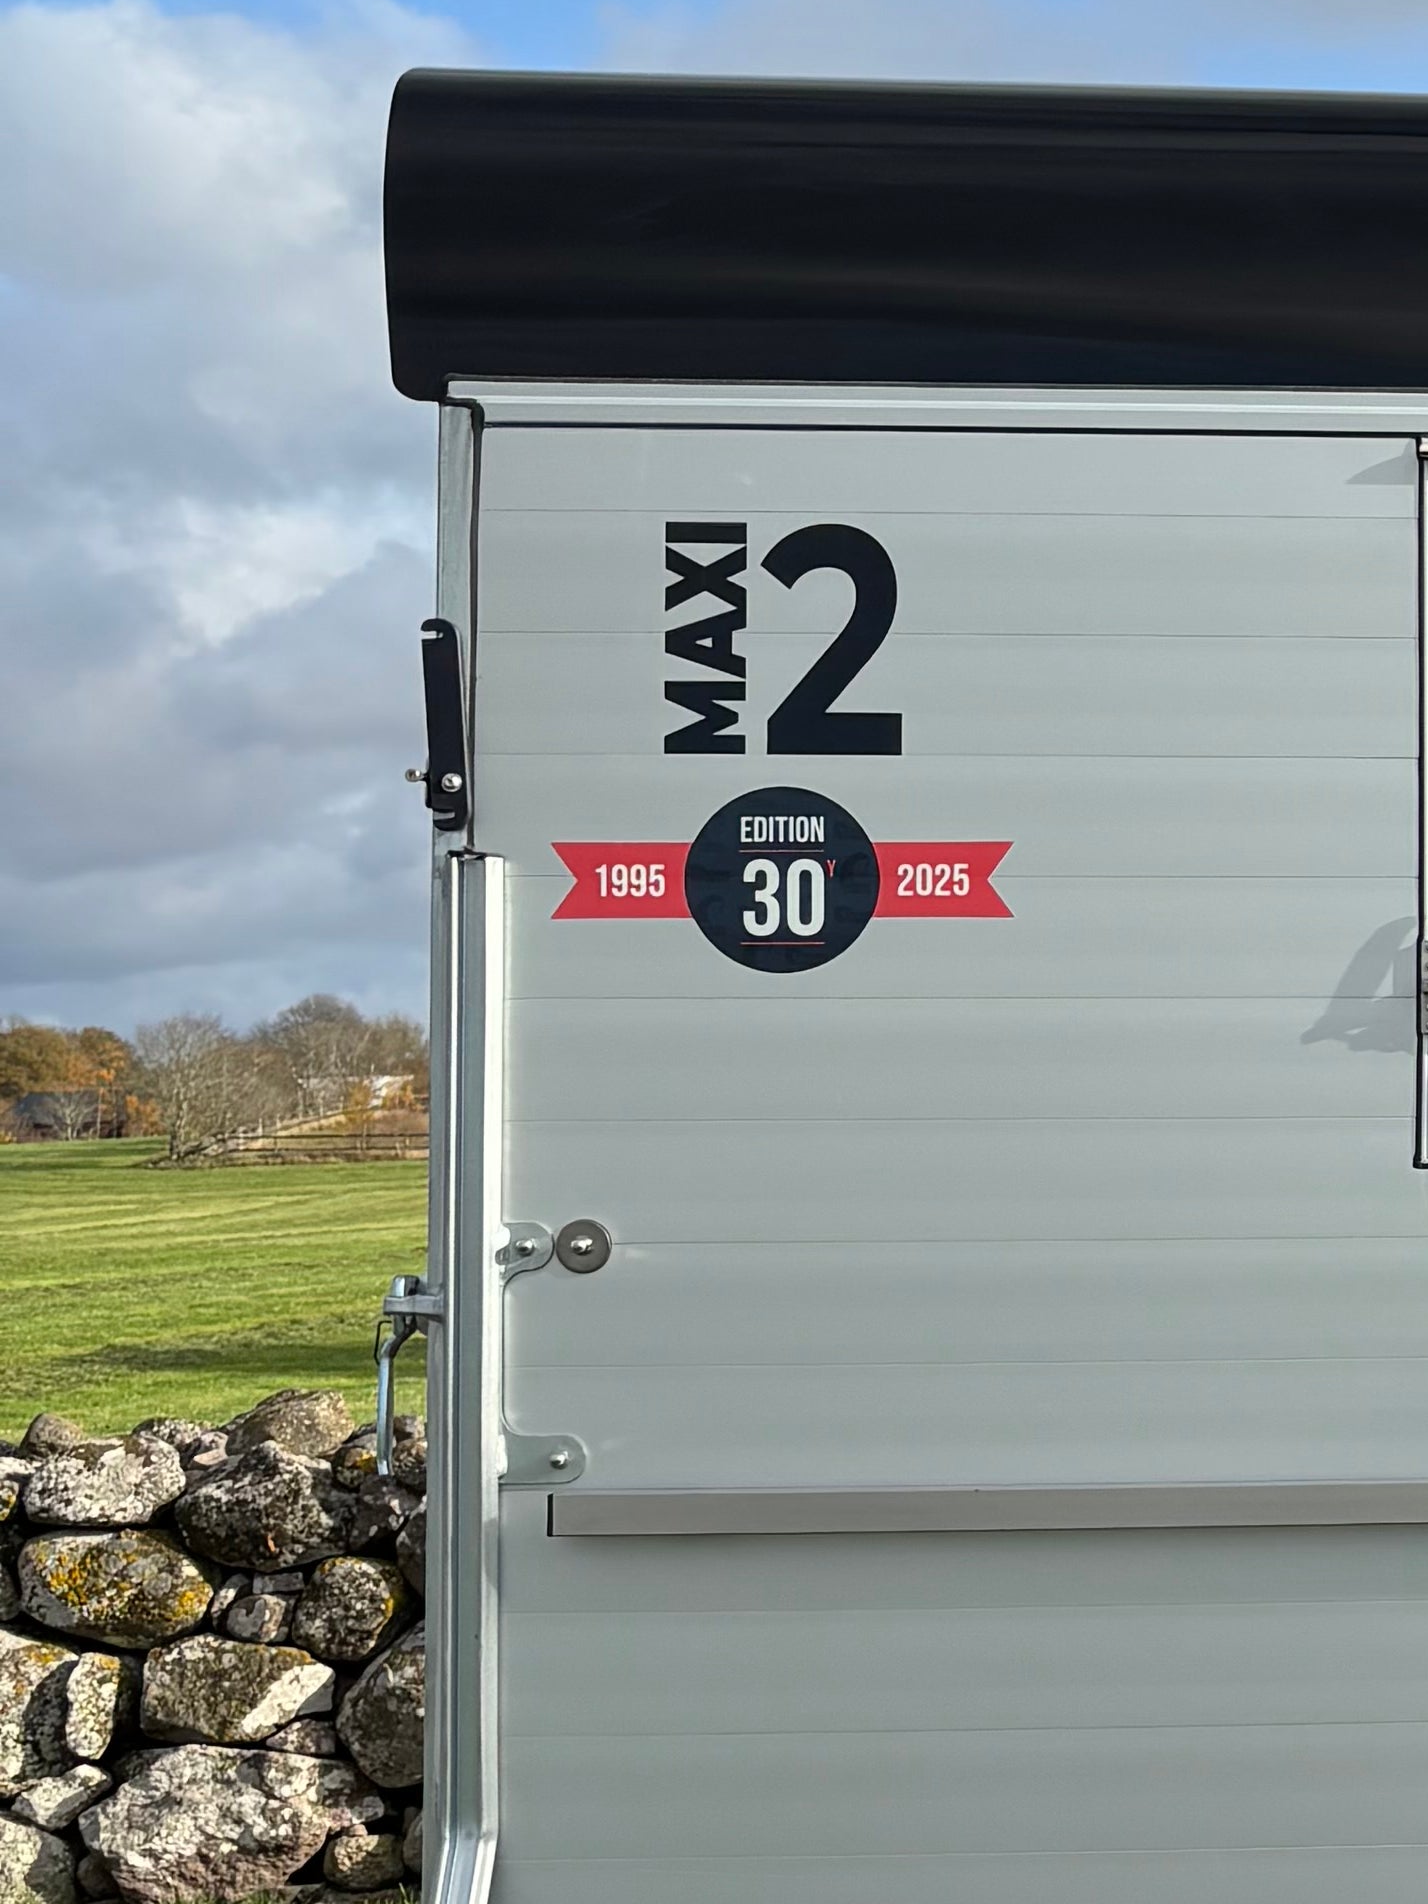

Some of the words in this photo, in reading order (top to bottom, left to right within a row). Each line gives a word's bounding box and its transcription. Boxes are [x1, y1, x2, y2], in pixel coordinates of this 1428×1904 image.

[664, 521, 748, 755] MAXI
[760, 522, 903, 756] 2
[740, 815, 825, 843] EDITION
[595, 863, 666, 897] 1995
[896, 863, 971, 897] 2025
